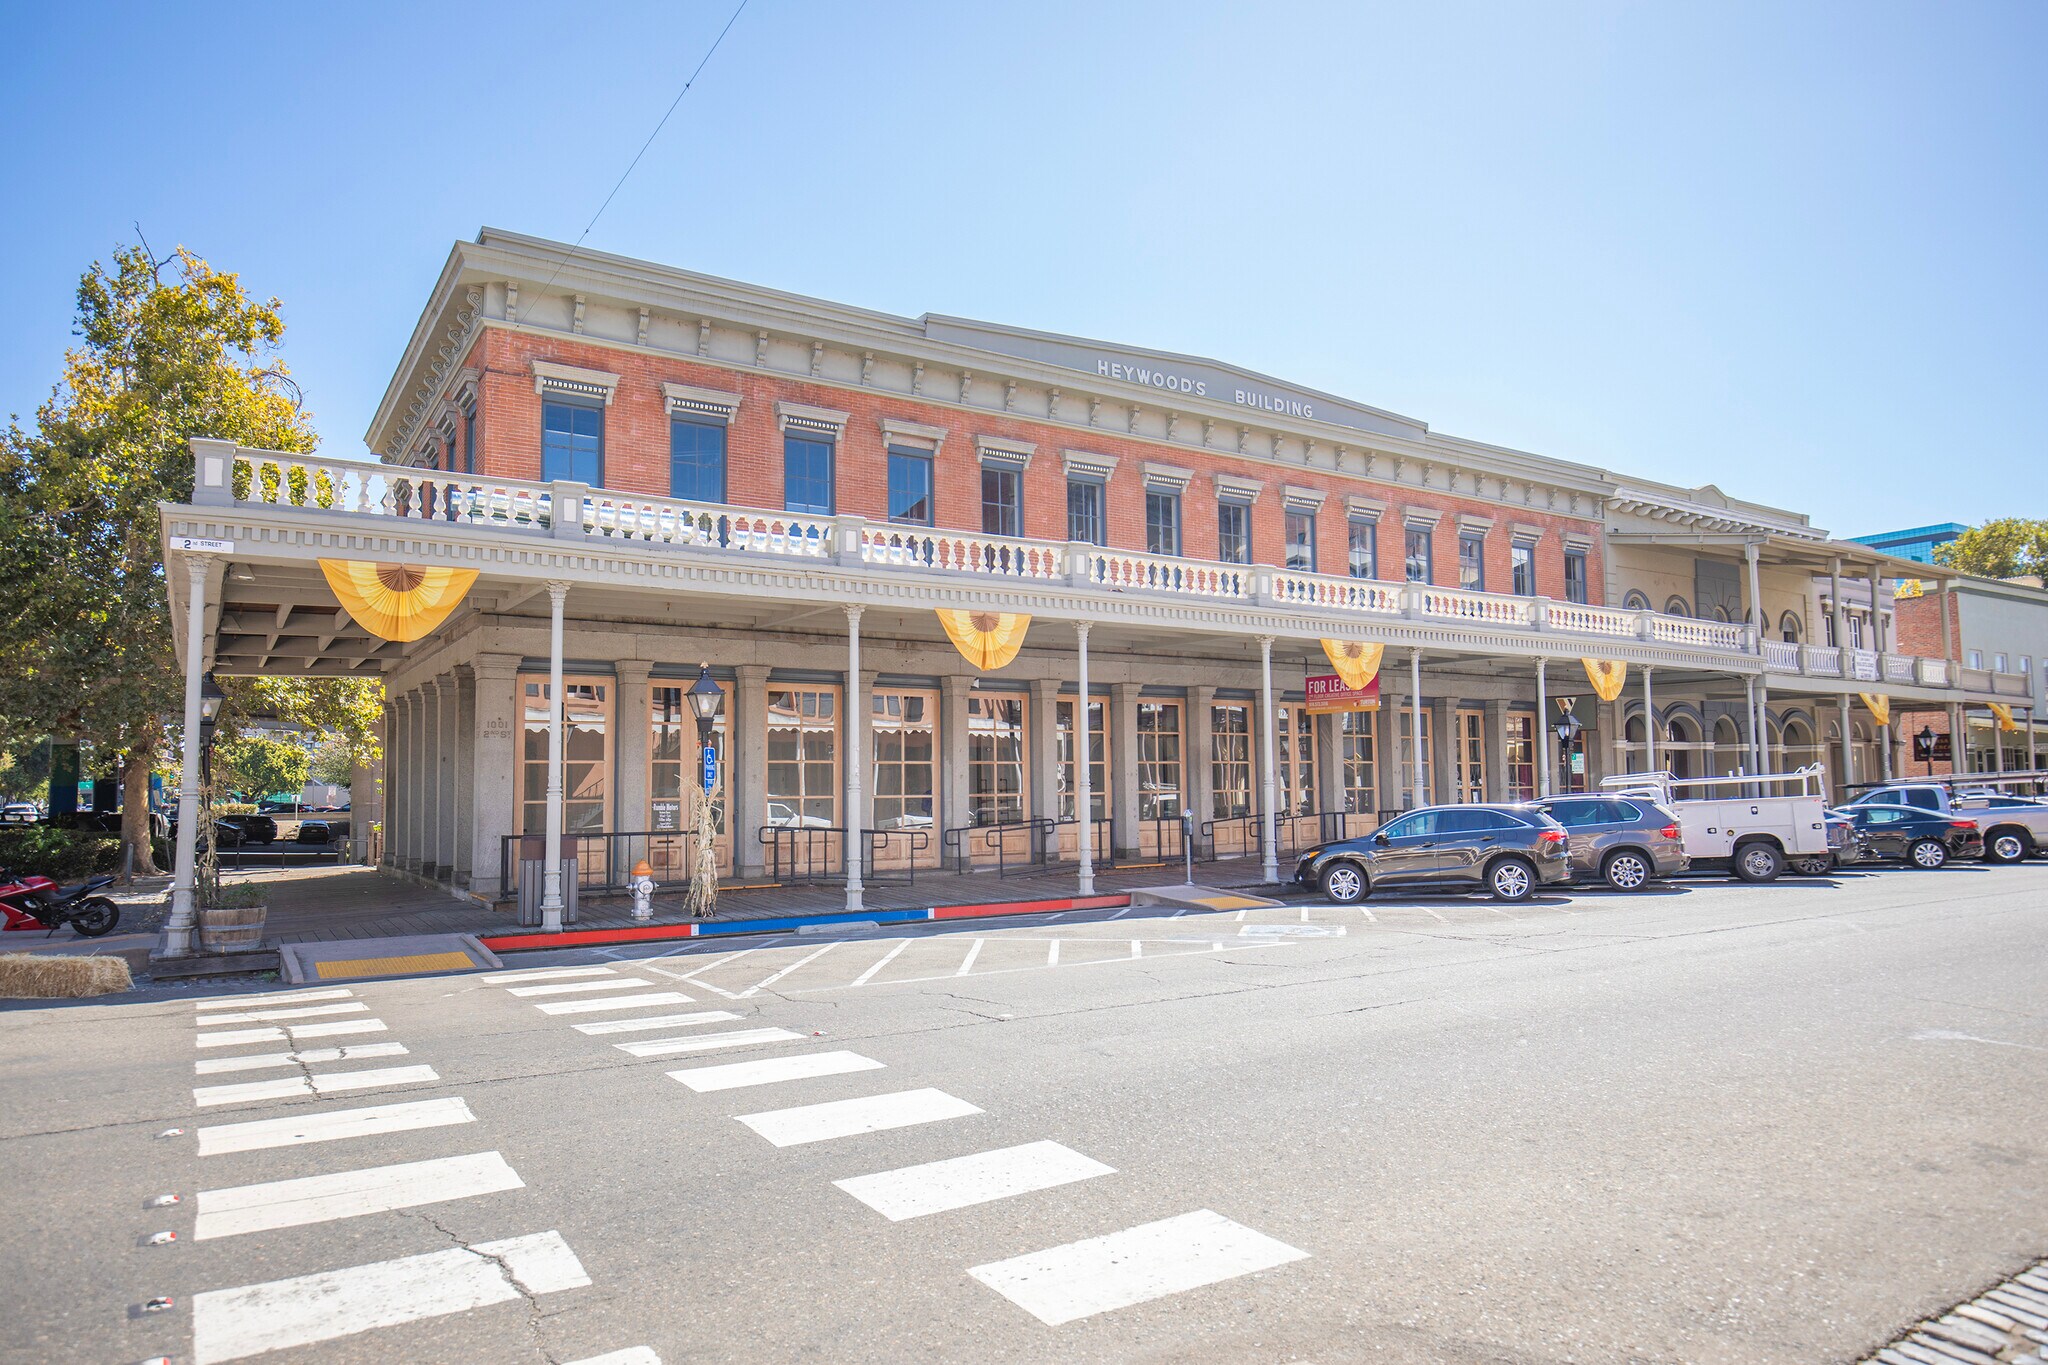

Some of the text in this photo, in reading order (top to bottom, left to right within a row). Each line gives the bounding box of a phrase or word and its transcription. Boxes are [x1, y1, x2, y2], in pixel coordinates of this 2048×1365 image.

[1097, 359, 1313, 418] HEYWOOD'S BUILDING
[200, 540, 223, 549] STREET
[1308, 680, 1326, 694] FOR
[486, 720, 508, 729] 1001
